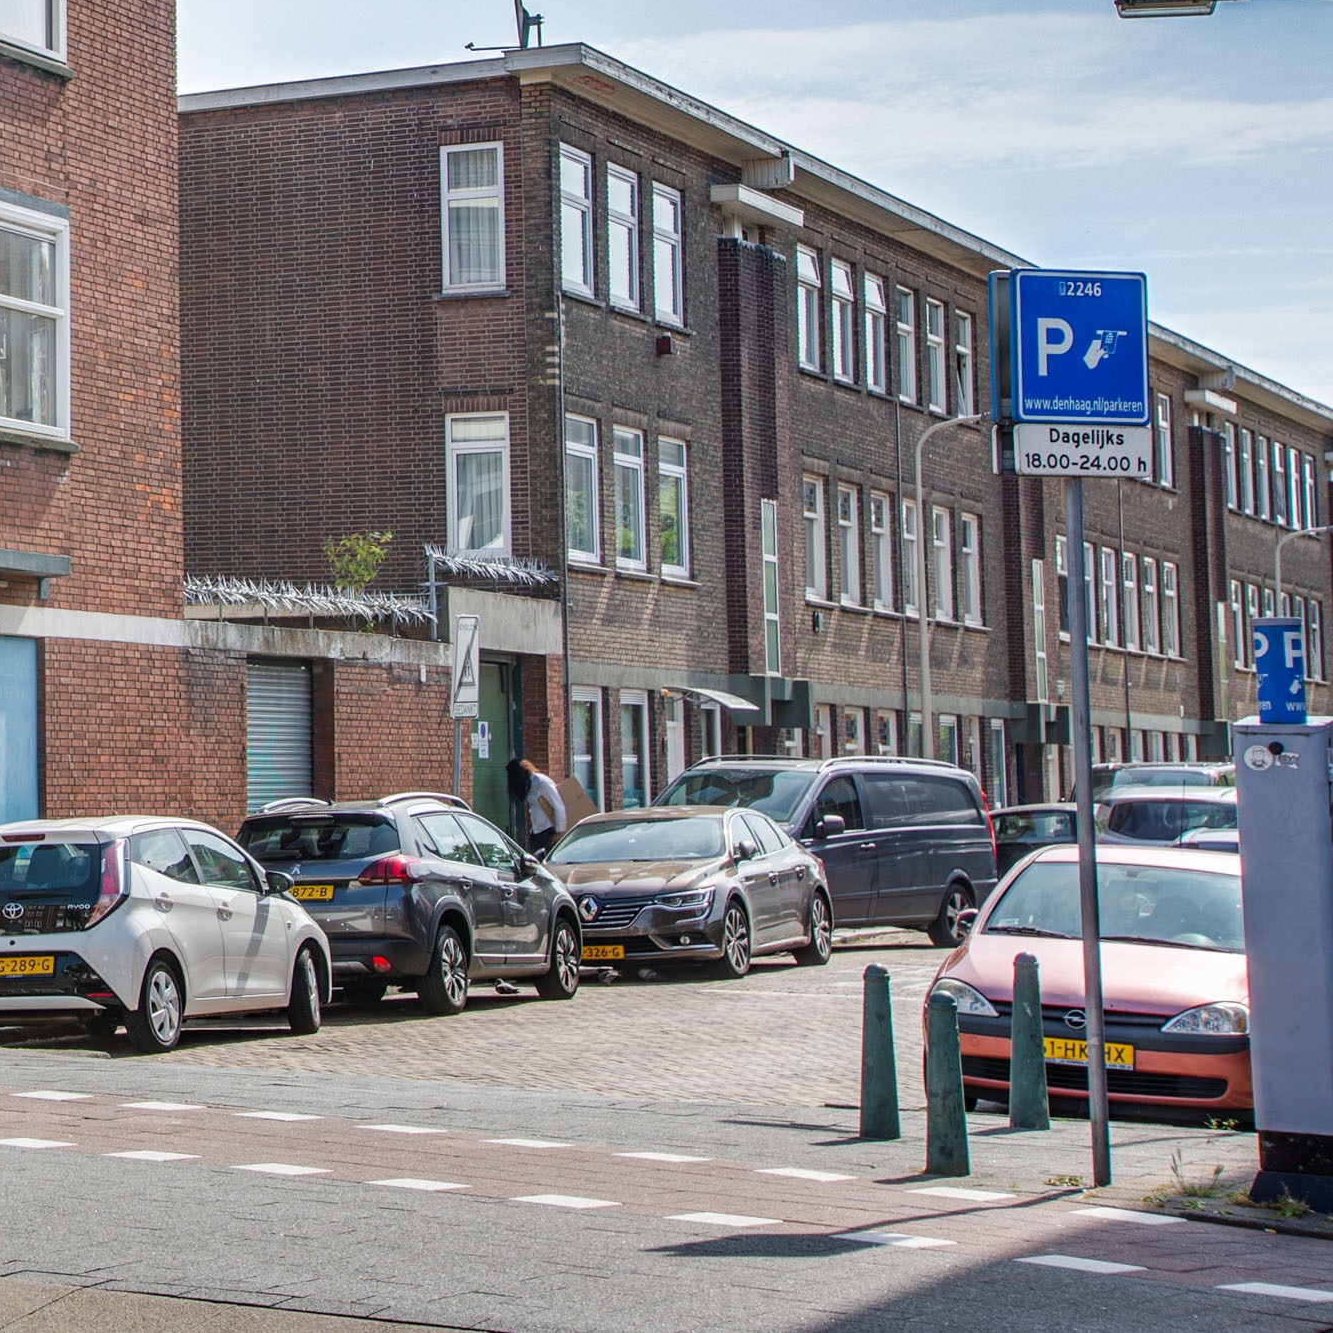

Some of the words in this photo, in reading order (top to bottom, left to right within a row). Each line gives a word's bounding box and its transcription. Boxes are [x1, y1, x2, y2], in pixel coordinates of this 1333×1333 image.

[1067, 282, 1102, 297] 2246
[1037, 317, 1074, 376] P
[1025, 395, 1143, 415] www.denhaag.nl/parkeren
[1049, 428, 1124, 450] Dagelijks
[1025, 453, 1130, 472] 18.00-24.00
[1137, 456, 1147, 472] h
